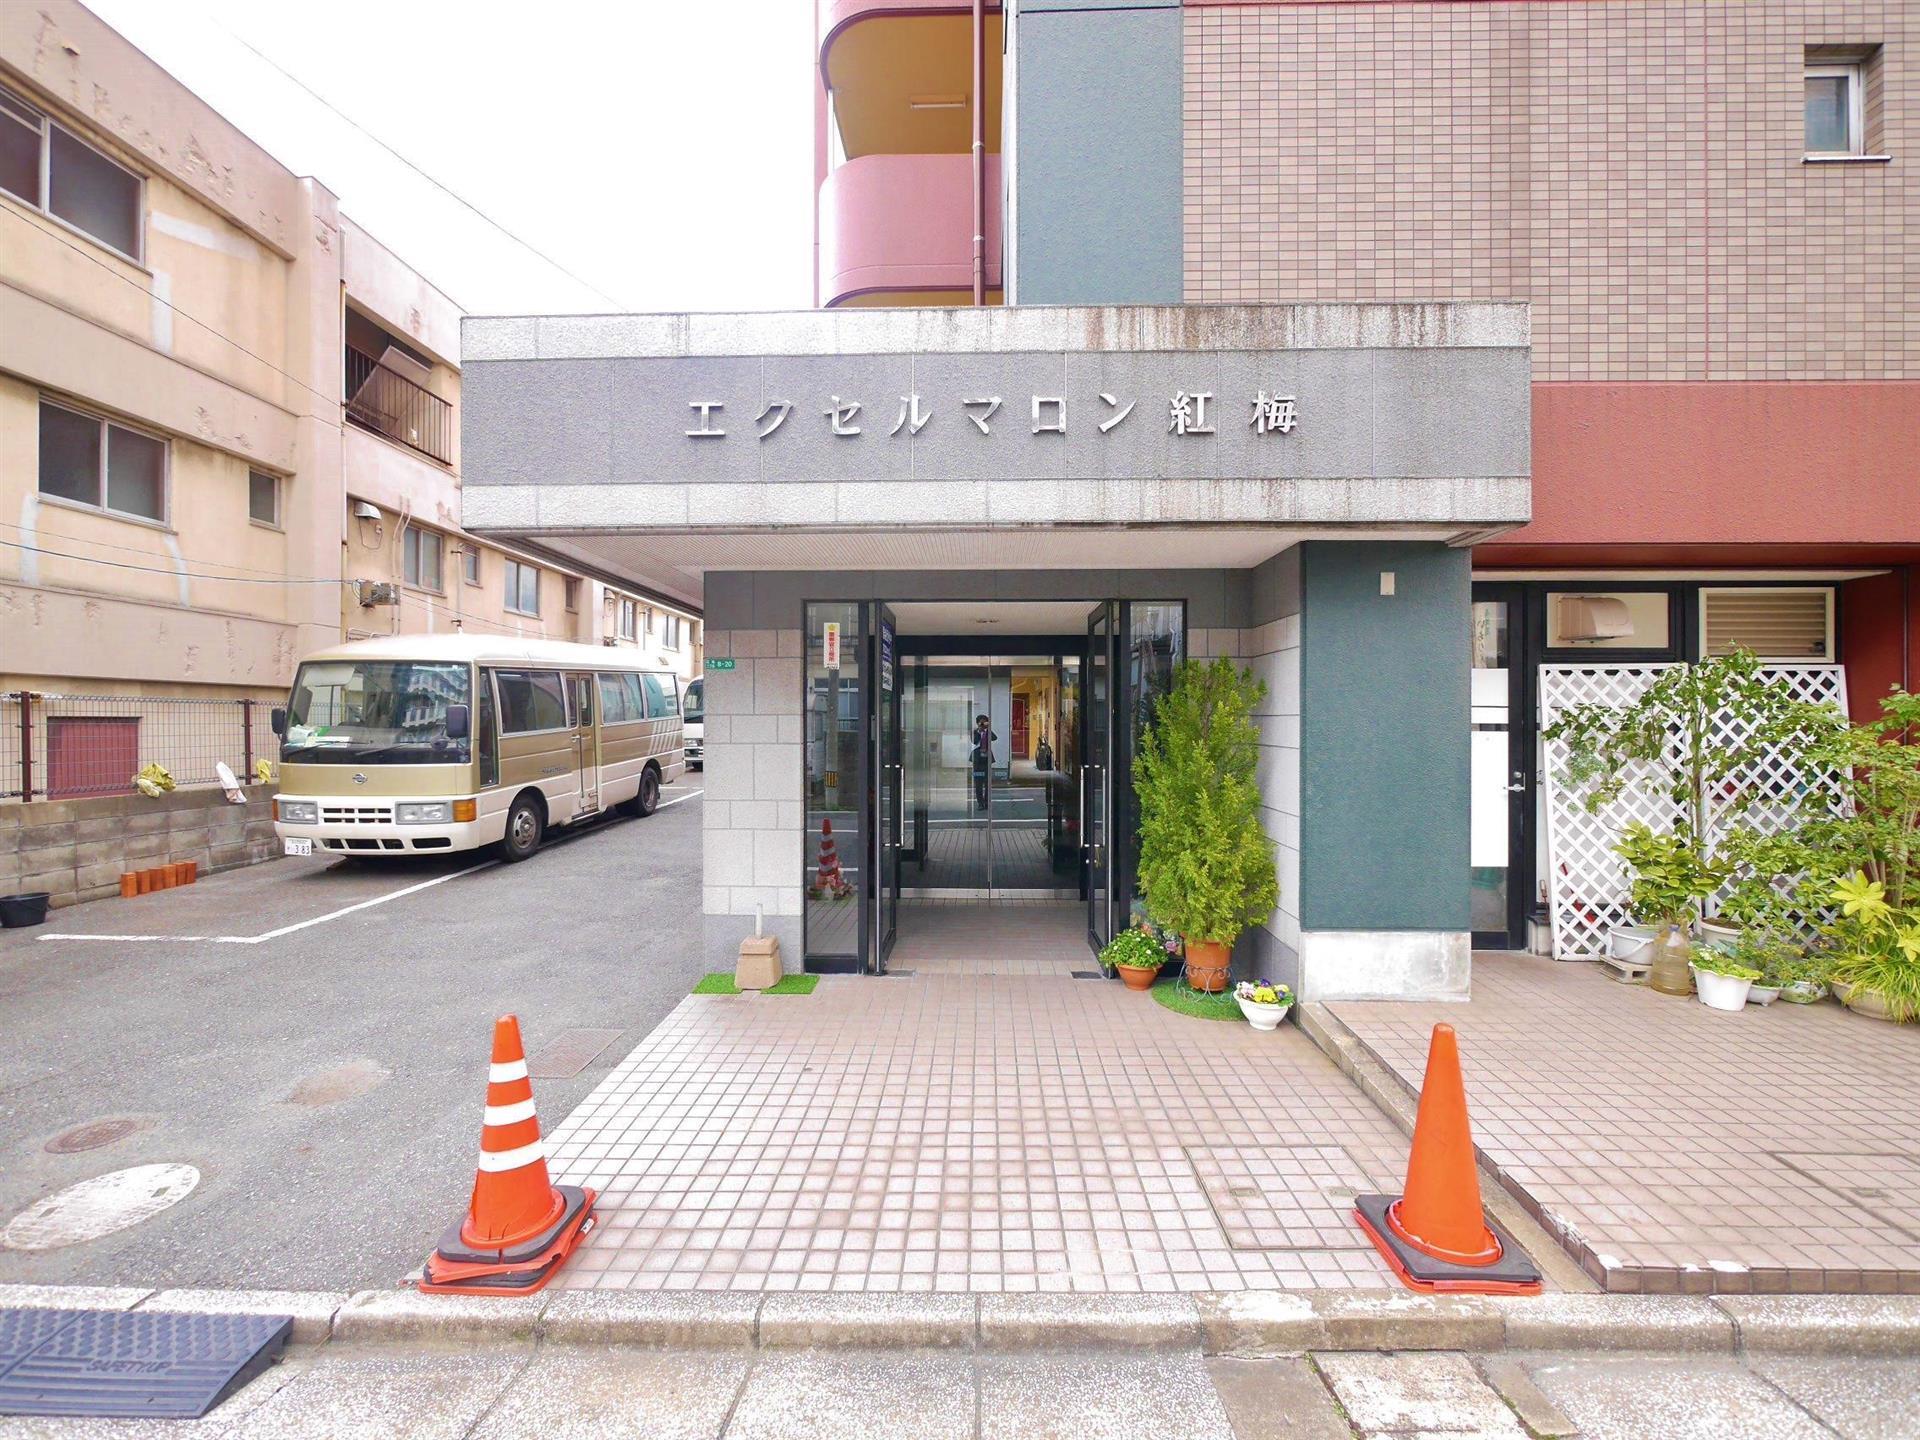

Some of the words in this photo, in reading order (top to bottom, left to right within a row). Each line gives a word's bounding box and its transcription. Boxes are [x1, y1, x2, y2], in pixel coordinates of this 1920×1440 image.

[685, 390, 1299, 438] エクセルマロン紅梅
